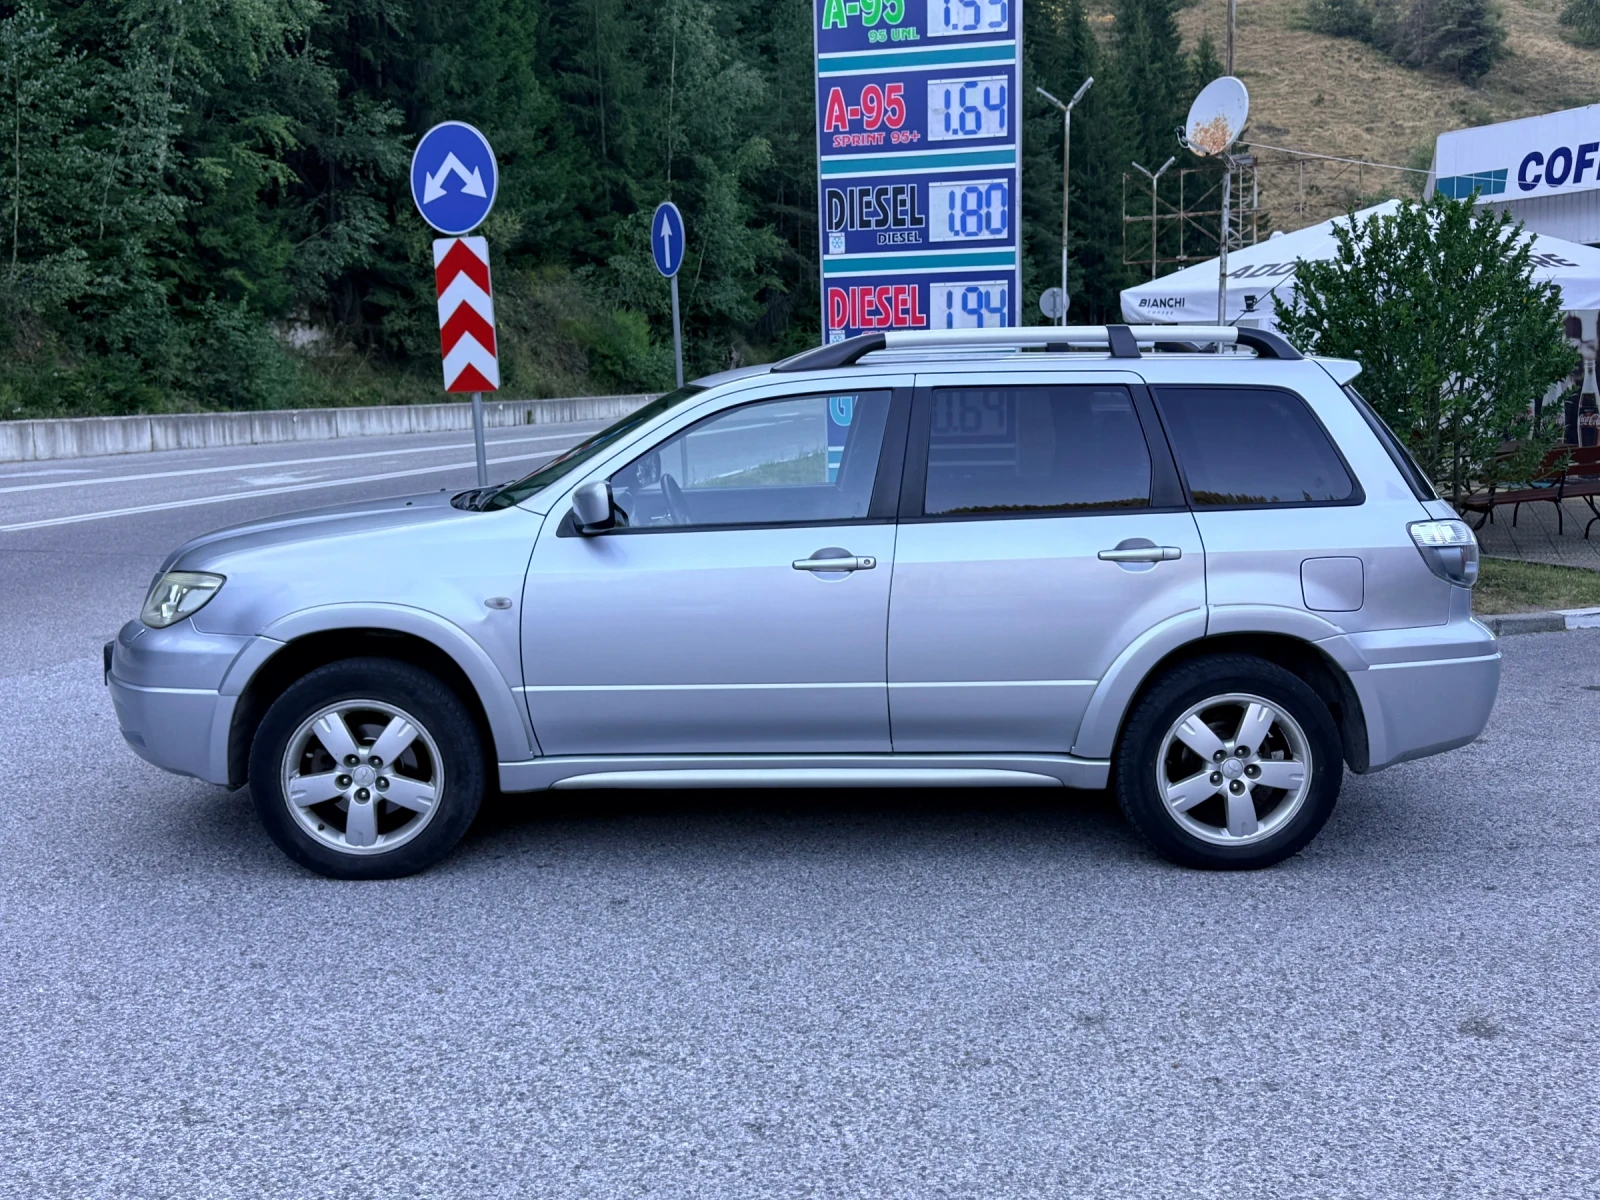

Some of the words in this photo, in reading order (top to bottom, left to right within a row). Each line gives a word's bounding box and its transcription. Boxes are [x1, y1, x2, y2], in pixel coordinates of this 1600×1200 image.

[822, 0, 905, 29] A-95
[868, 30, 887, 42] 95
[891, 27, 920, 41] UNL
[824, 83, 906, 132] A-95
[944, 81, 1006, 135] 1.64
[833, 132, 885, 147] SPRINT
[891, 131, 920, 144] 95+
[1518, 142, 1600, 191] COF
[826, 184, 925, 232] DIESEL
[949, 182, 1008, 236] 1.80
[877, 231, 922, 245] DIESEL
[828, 284, 926, 329] DIESEL
[1138, 297, 1185, 308] BIANCHI
[829, 396, 853, 426] G
